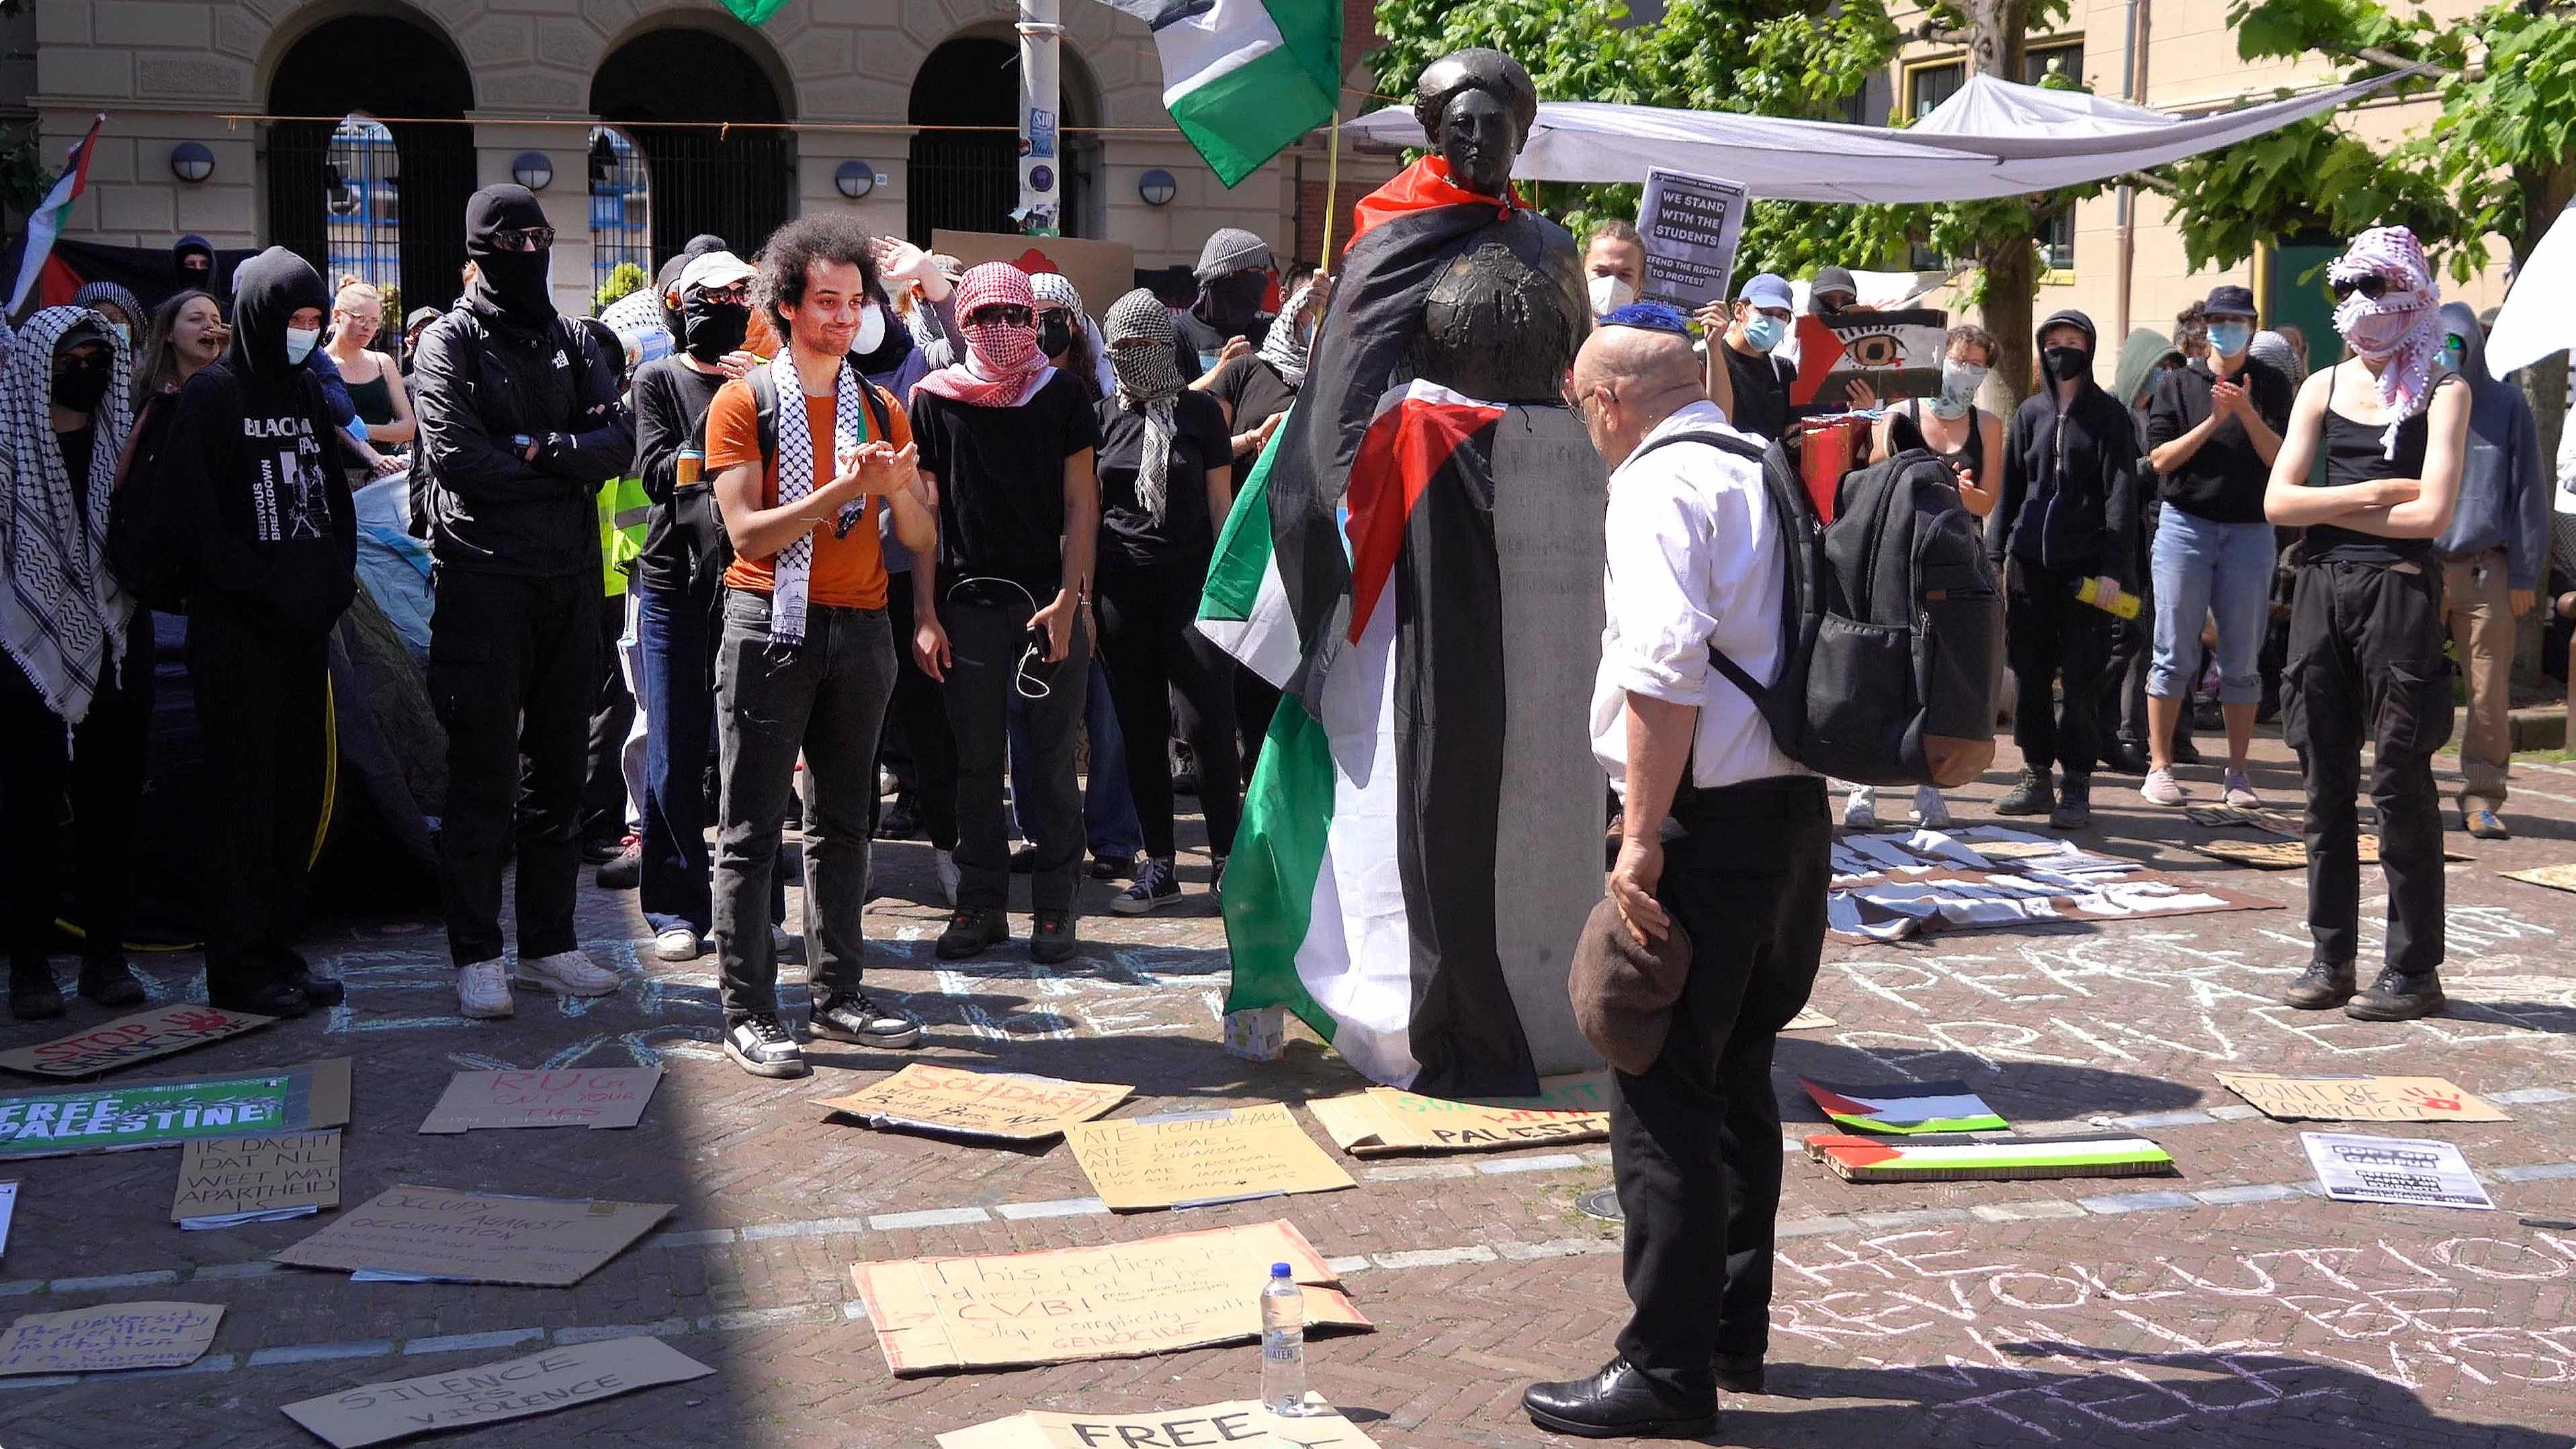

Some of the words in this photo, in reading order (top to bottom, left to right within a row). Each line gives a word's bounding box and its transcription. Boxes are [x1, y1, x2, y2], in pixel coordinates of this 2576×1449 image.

[1663, 191, 1682, 204] WE
[1684, 195, 1725, 212] STAND
[1662, 208, 1694, 224] WITH
[1697, 215, 1720, 229] THE
[1656, 224, 1718, 246] STUDENTS
[1646, 255, 1674, 268] EFEND
[1676, 259, 1691, 270] THE
[1692, 263, 1721, 277] RIGHT
[1651, 269, 1664, 278] TO
[1666, 271, 1705, 286] PROTEST
[261, 459, 281, 541] BREAKDOWN
[253, 482, 269, 541] NERVOUS
[1827, 934, 2307, 1013] PEACE
[34, 1024, 153, 1061] STOP
[490, 1071, 625, 1091] RUG
[576, 1092, 636, 1104] YOUR
[2338, 1084, 2391, 1105] BE
[0, 1098, 123, 1123] FREE
[2262, 1100, 2425, 1118] COMPLICIT
[1431, 1116, 1610, 1143] PALEST
[196, 1139, 226, 1154] IK
[241, 1133, 333, 1152] DACHT
[1150, 1144, 1248, 1163] ZIONISM
[1153, 1135, 1244, 1153] ISRAEL
[200, 1155, 260, 1170] DAT
[275, 1151, 331, 1166] NL
[1191, 1153, 1285, 1171] ARSENAL
[187, 1171, 272, 1188] WEET
[285, 1166, 338, 1182] WAT
[177, 1180, 337, 1205] APARTHEID
[376, 1194, 499, 1212] OCCUPY
[349, 1217, 515, 1242] OCCUPATION
[465, 1214, 577, 1231] AGAINST
[933, 1256, 1043, 1287] This
[1060, 1248, 1187, 1280] action
[951, 1282, 1075, 1303] directed
[1094, 1274, 1121, 1292] at
[956, 1297, 1094, 1321] CVB!
[971, 1321, 1037, 1342] Stop
[1054, 1306, 1183, 1333] complicity
[1051, 1321, 1203, 1350] GENOCIDE
[1265, 1348, 1293, 1360] WATER
[338, 1352, 585, 1411] SILENCE
[408, 1372, 626, 1425] VIOLENCE
[456, 1387, 519, 1404] IS
[1071, 1412, 1268, 1449] FREE
